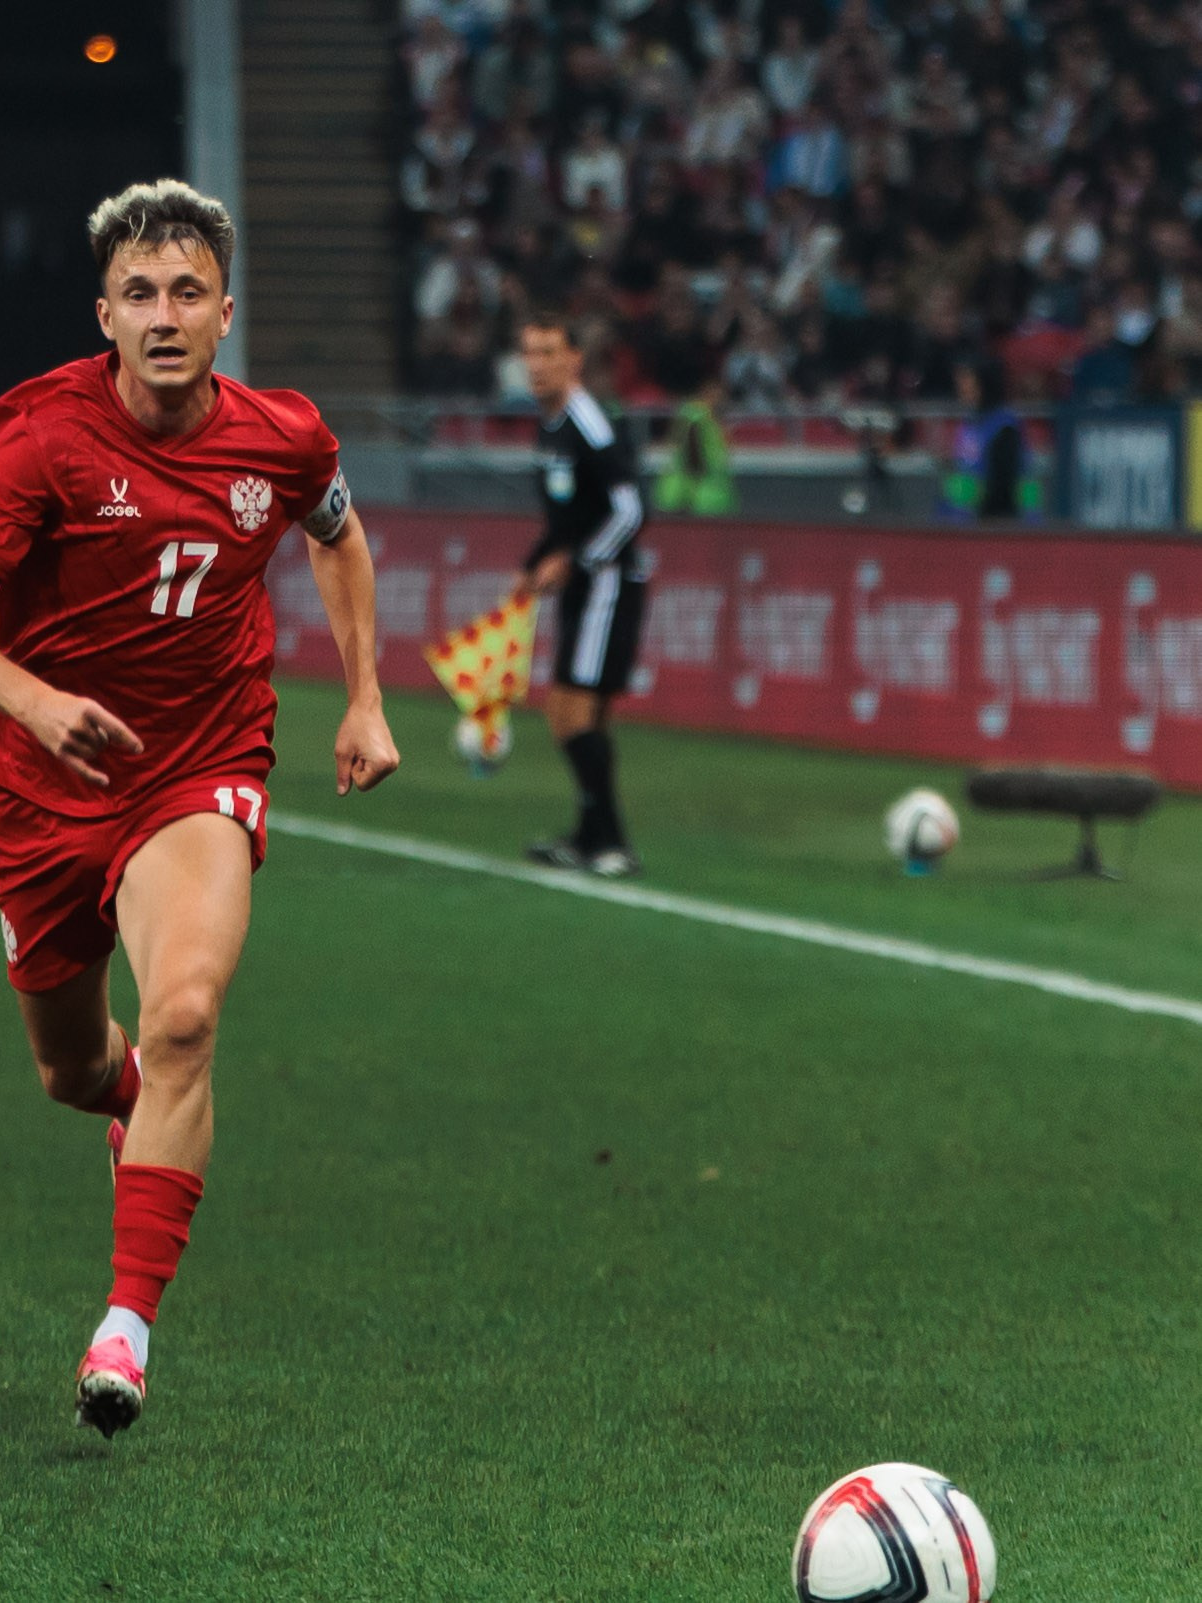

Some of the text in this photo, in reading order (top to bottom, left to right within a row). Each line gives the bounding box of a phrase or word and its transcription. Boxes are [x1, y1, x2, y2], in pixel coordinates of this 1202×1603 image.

[97, 505, 142, 518] JOGEL
[150, 541, 219, 618] 17
[214, 787, 262, 832] 17
